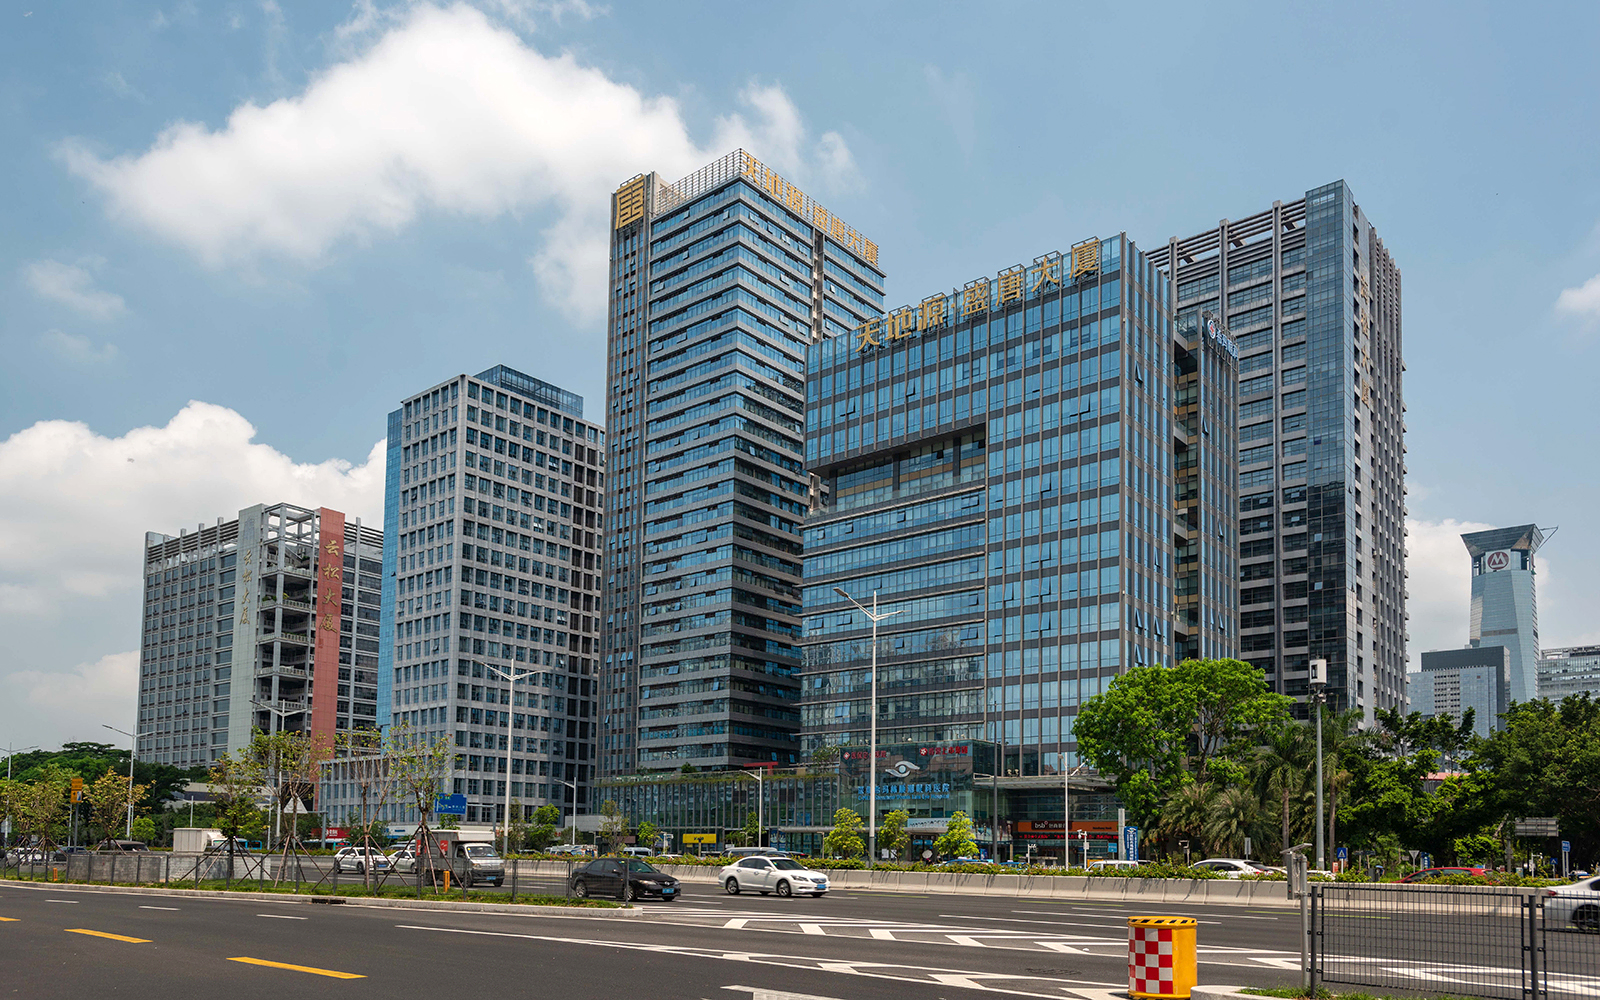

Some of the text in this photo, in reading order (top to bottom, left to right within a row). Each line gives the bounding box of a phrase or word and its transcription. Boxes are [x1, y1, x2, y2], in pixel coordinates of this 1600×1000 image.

[239, 550, 252, 625] 云松大厦
[319, 539, 340, 633] 云松大厦
[850, 750, 887, 760] 医保定医院
